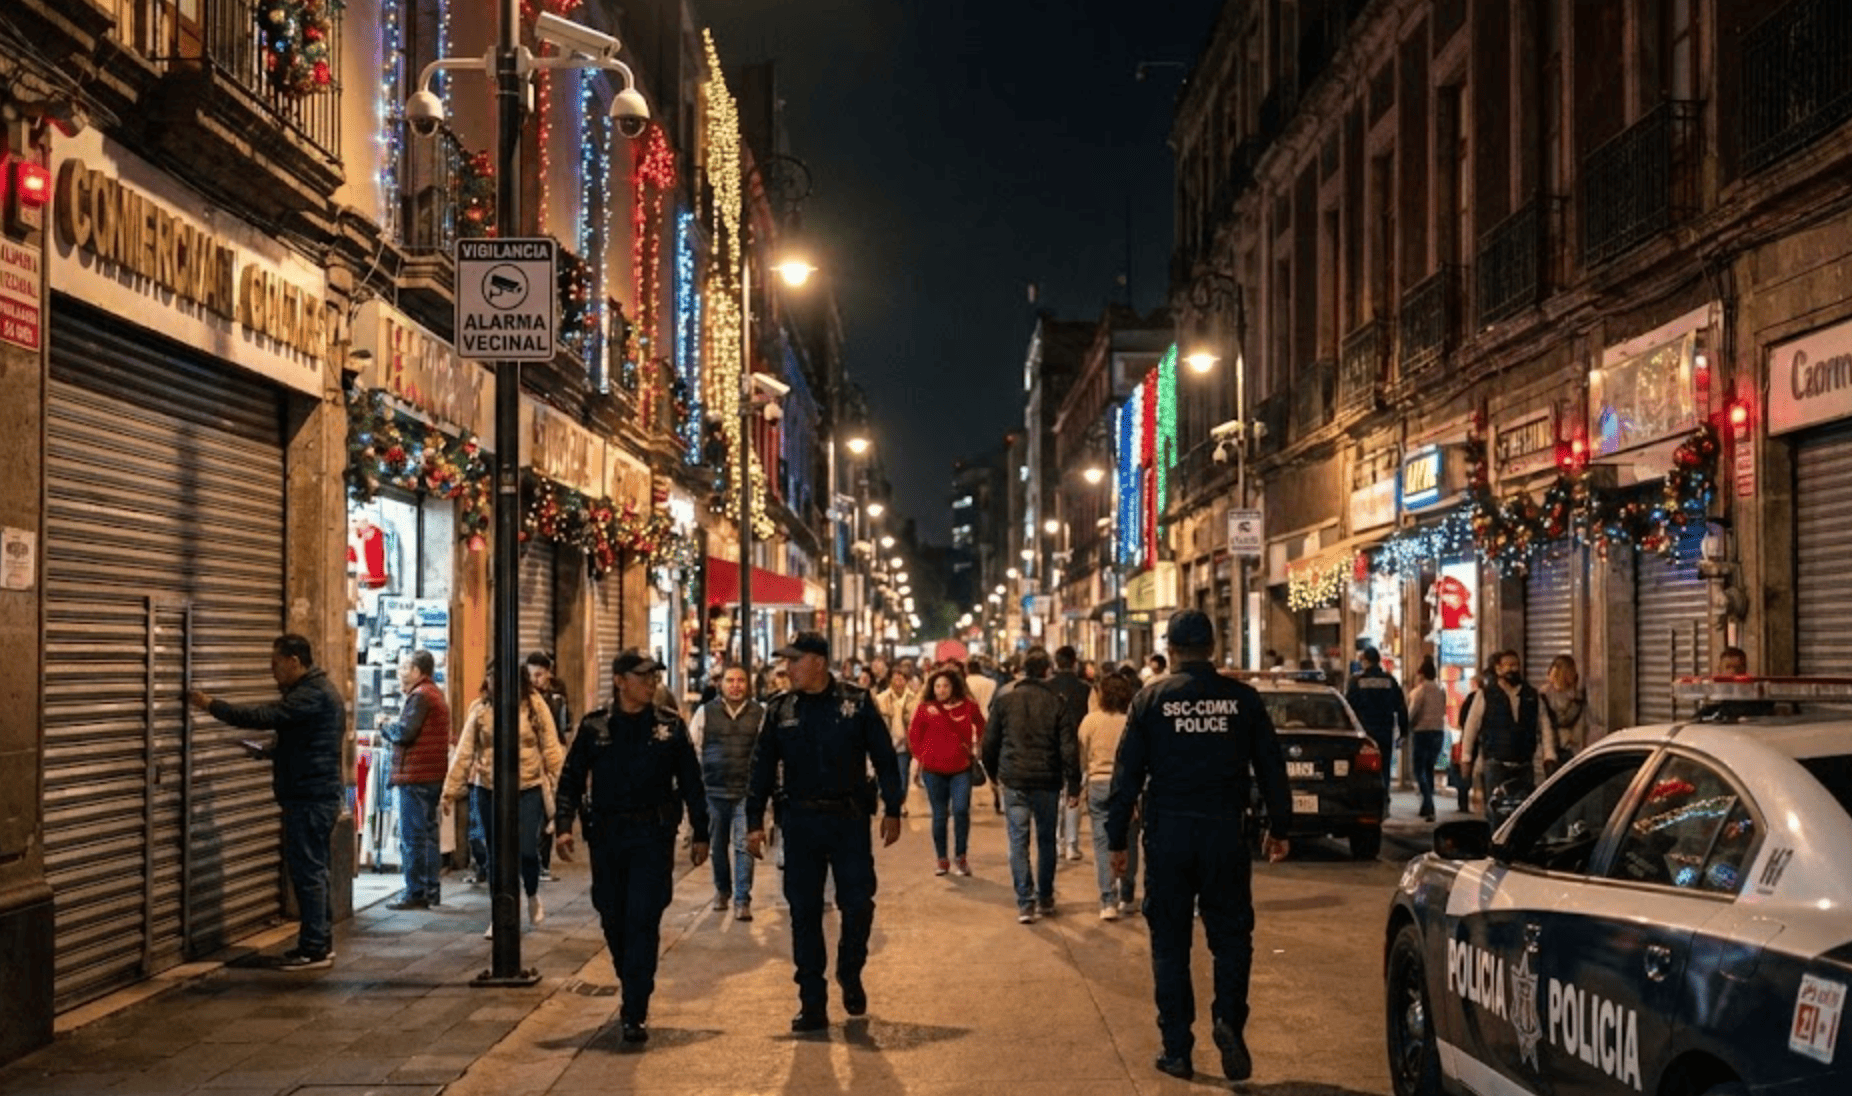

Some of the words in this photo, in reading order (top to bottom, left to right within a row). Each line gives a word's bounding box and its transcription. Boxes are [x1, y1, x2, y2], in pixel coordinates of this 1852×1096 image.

[462, 244, 548, 258] VIGILANCIA
[464, 314, 546, 331] ALARMA
[463, 335, 547, 351] VECINAL
[1163, 700, 1238, 717] SSC-CDMX
[1175, 716, 1228, 733] POLICE
[1448, 938, 1507, 1021] POLICIA
[1549, 977, 1642, 1092] POLICIA
